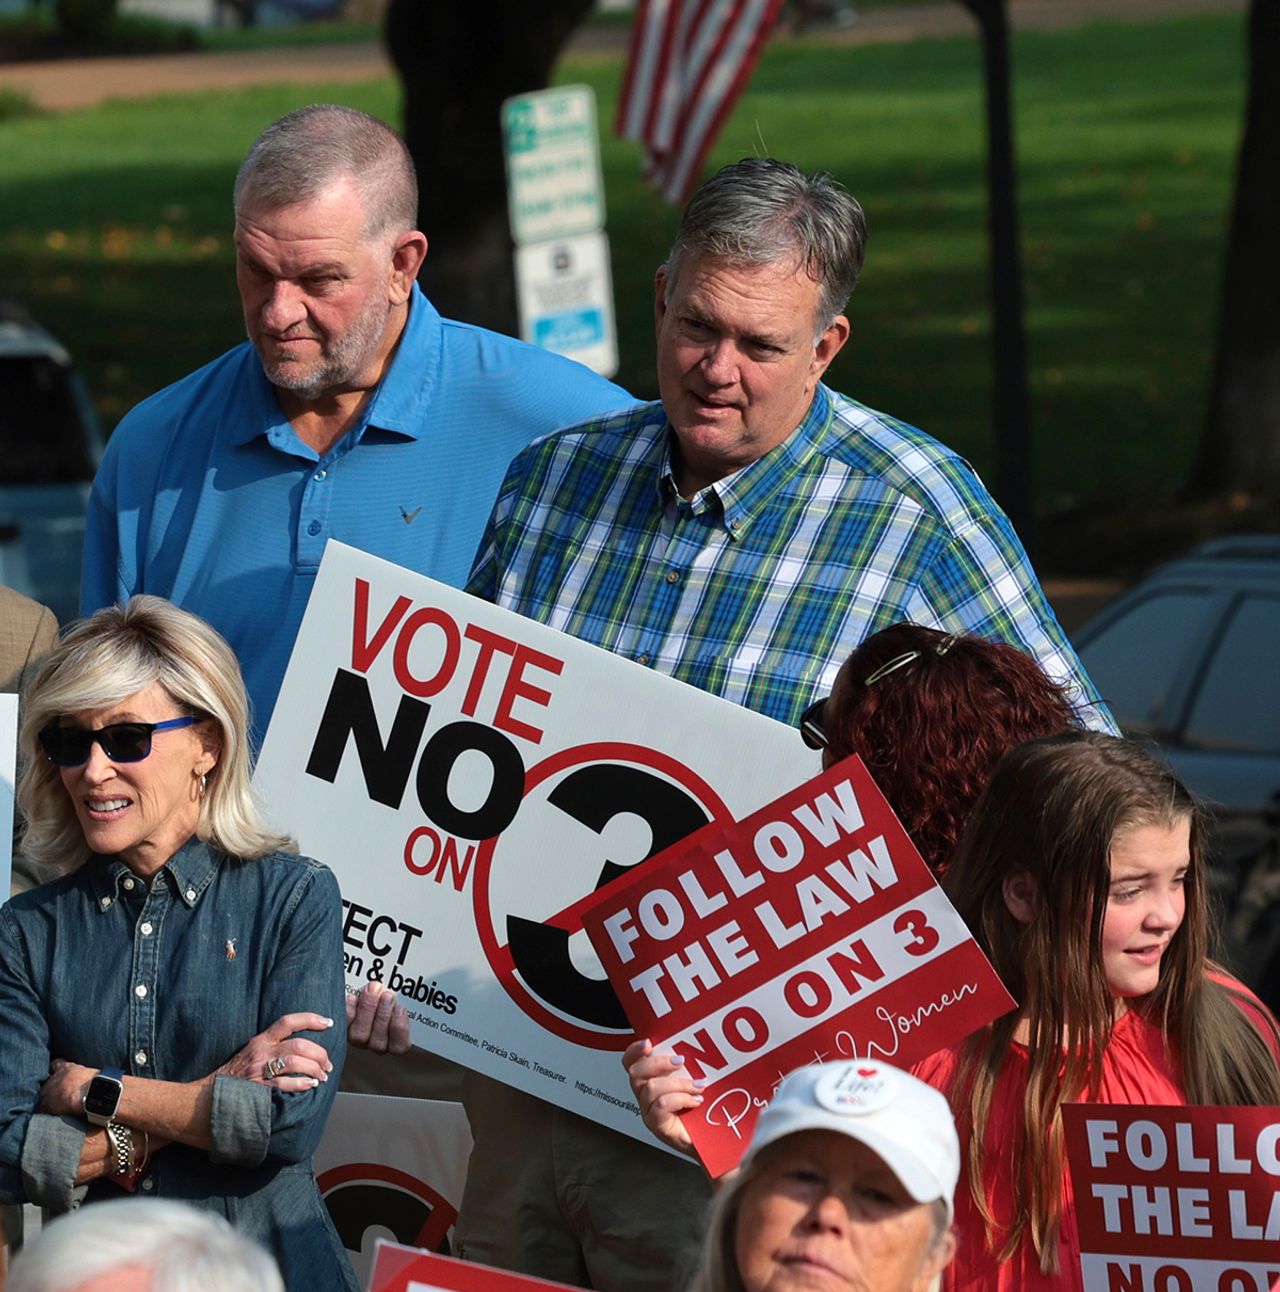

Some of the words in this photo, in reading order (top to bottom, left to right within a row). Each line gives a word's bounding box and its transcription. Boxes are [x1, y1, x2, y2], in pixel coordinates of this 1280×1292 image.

[352, 577, 565, 745] VOTE
[305, 667, 526, 841] NO
[403, 825, 475, 892] ON
[603, 778, 866, 964] FOLLOW
[629, 919, 760, 1019] THE
[753, 834, 899, 950] LAW
[387, 965, 458, 1015] babies
[417, 1014, 439, 1030] Action
[440, 1023, 480, 1048] Committee,
[481, 1040, 508, 1059] Patricia
[508, 1052, 531, 1069] Skain,
[533, 1062, 568, 1084] Treasurer.
[672, 1005, 770, 1082] NO
[783, 938, 886, 1019] ON
[893, 909, 941, 957] 3
[835, 982, 978, 1062] Women
[1091, 1183, 1213, 1238] THE
